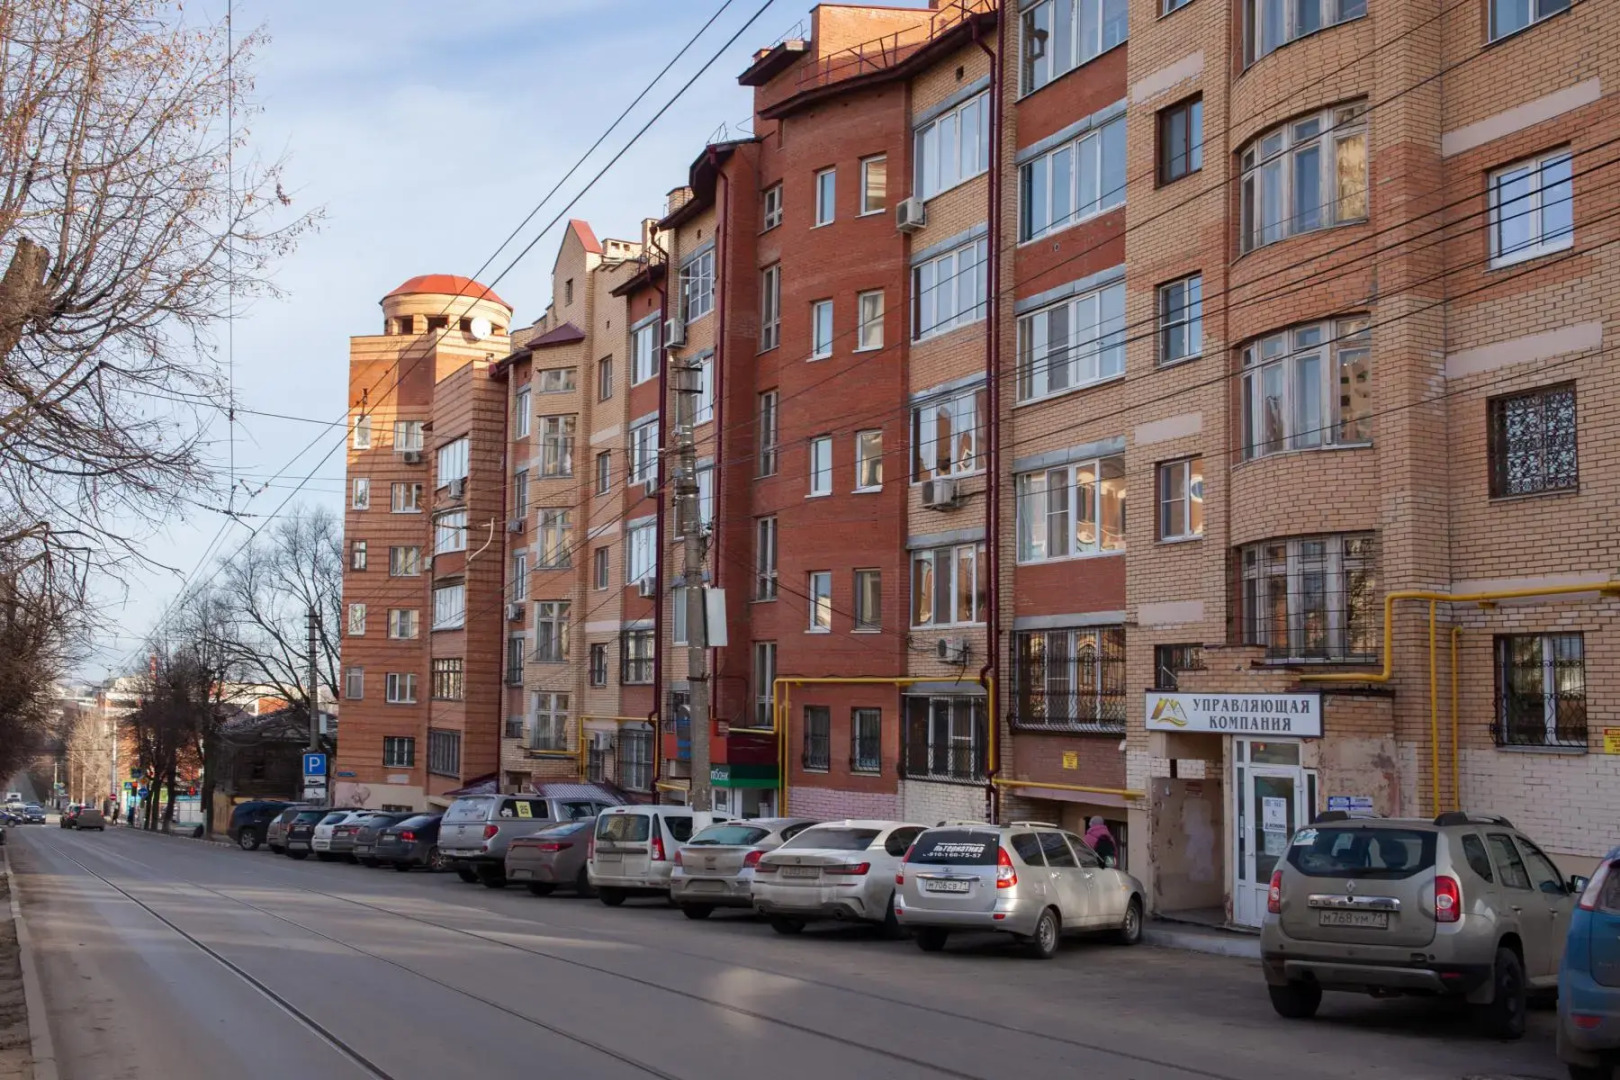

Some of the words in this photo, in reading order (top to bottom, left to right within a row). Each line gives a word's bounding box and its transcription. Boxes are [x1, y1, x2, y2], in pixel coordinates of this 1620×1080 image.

[1193, 699, 1310, 715] УПРАВЛЯЮЩАЯ
[1209, 716, 1292, 731] КОМПАНИЯ
[309, 756, 320, 772] P
